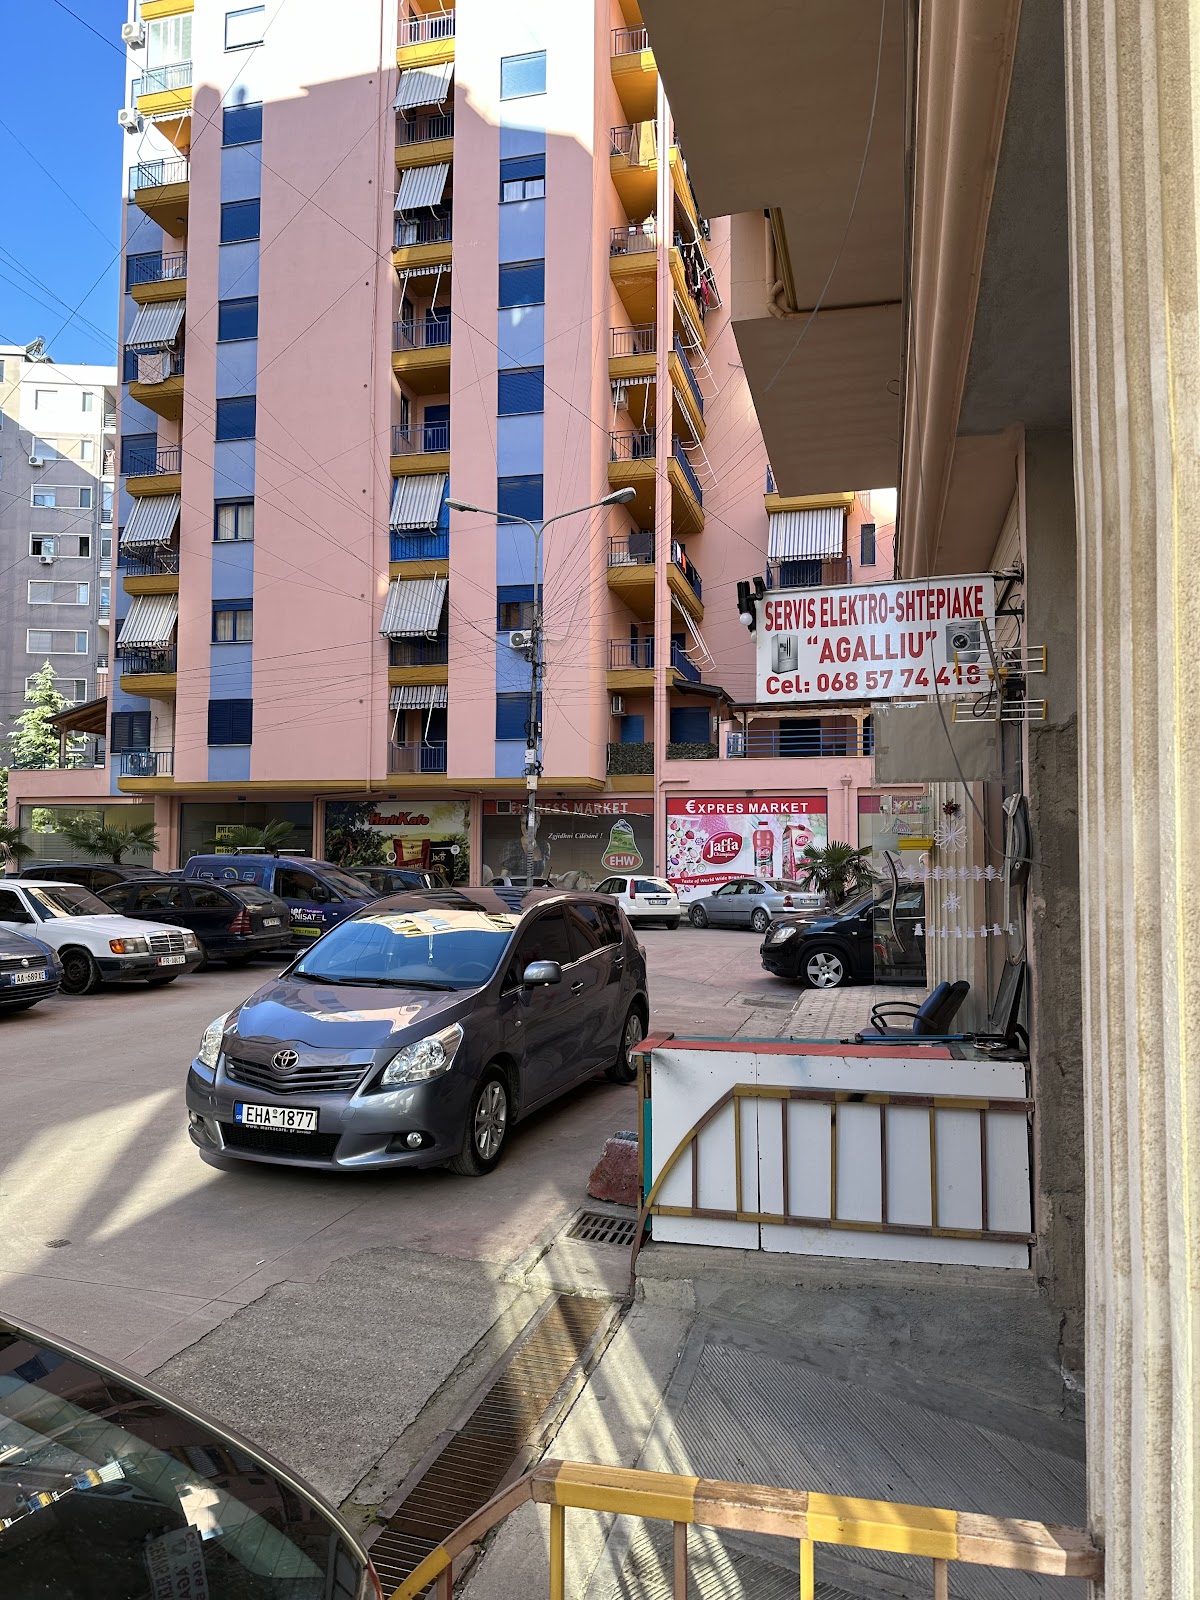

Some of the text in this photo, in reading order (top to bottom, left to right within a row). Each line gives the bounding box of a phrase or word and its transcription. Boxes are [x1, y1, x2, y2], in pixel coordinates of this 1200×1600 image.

[765, 585, 984, 631] SERVIS ELEKTRO-SHTEPIAKE
[766, 675, 810, 695] Cel:
[817, 671, 858, 693] 068
[866, 669, 893, 690] 57
[900, 667, 929, 688] 74
[573, 803, 628, 814] MARKET
[748, 802, 809, 813] MARKET
[707, 837, 739, 858] Jaffa
[609, 856, 635, 867] EHW
